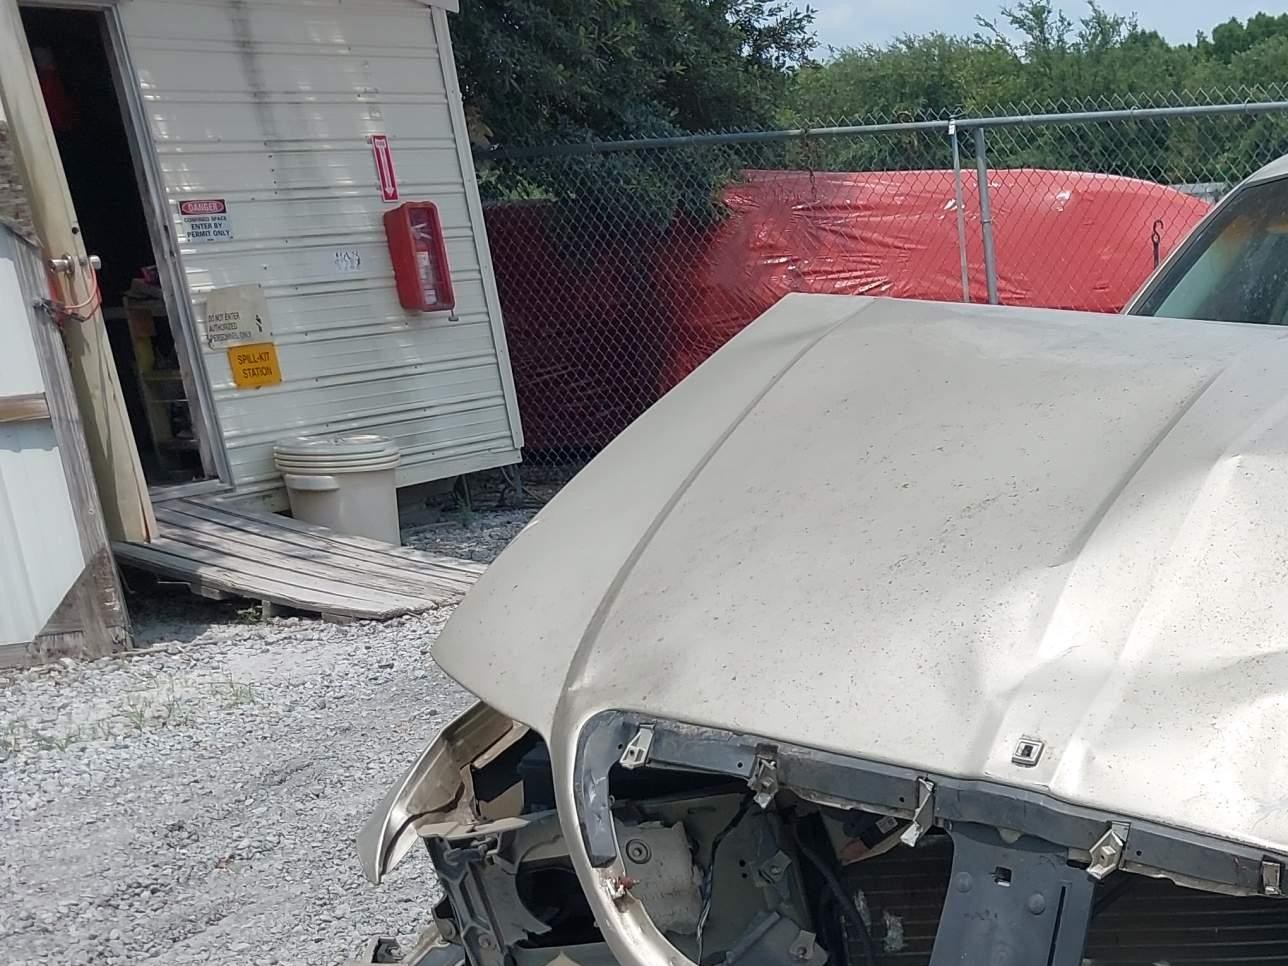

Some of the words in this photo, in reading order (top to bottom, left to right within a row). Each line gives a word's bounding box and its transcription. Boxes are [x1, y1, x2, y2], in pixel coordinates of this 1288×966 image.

[187, 202, 218, 212] DANGER
[187, 230, 210, 238] PERMIT
[213, 229, 230, 237] ONLY
[224, 312, 239, 320] ENTER
[237, 352, 269, 365] SPILL-KIT
[243, 367, 273, 378] STATION
